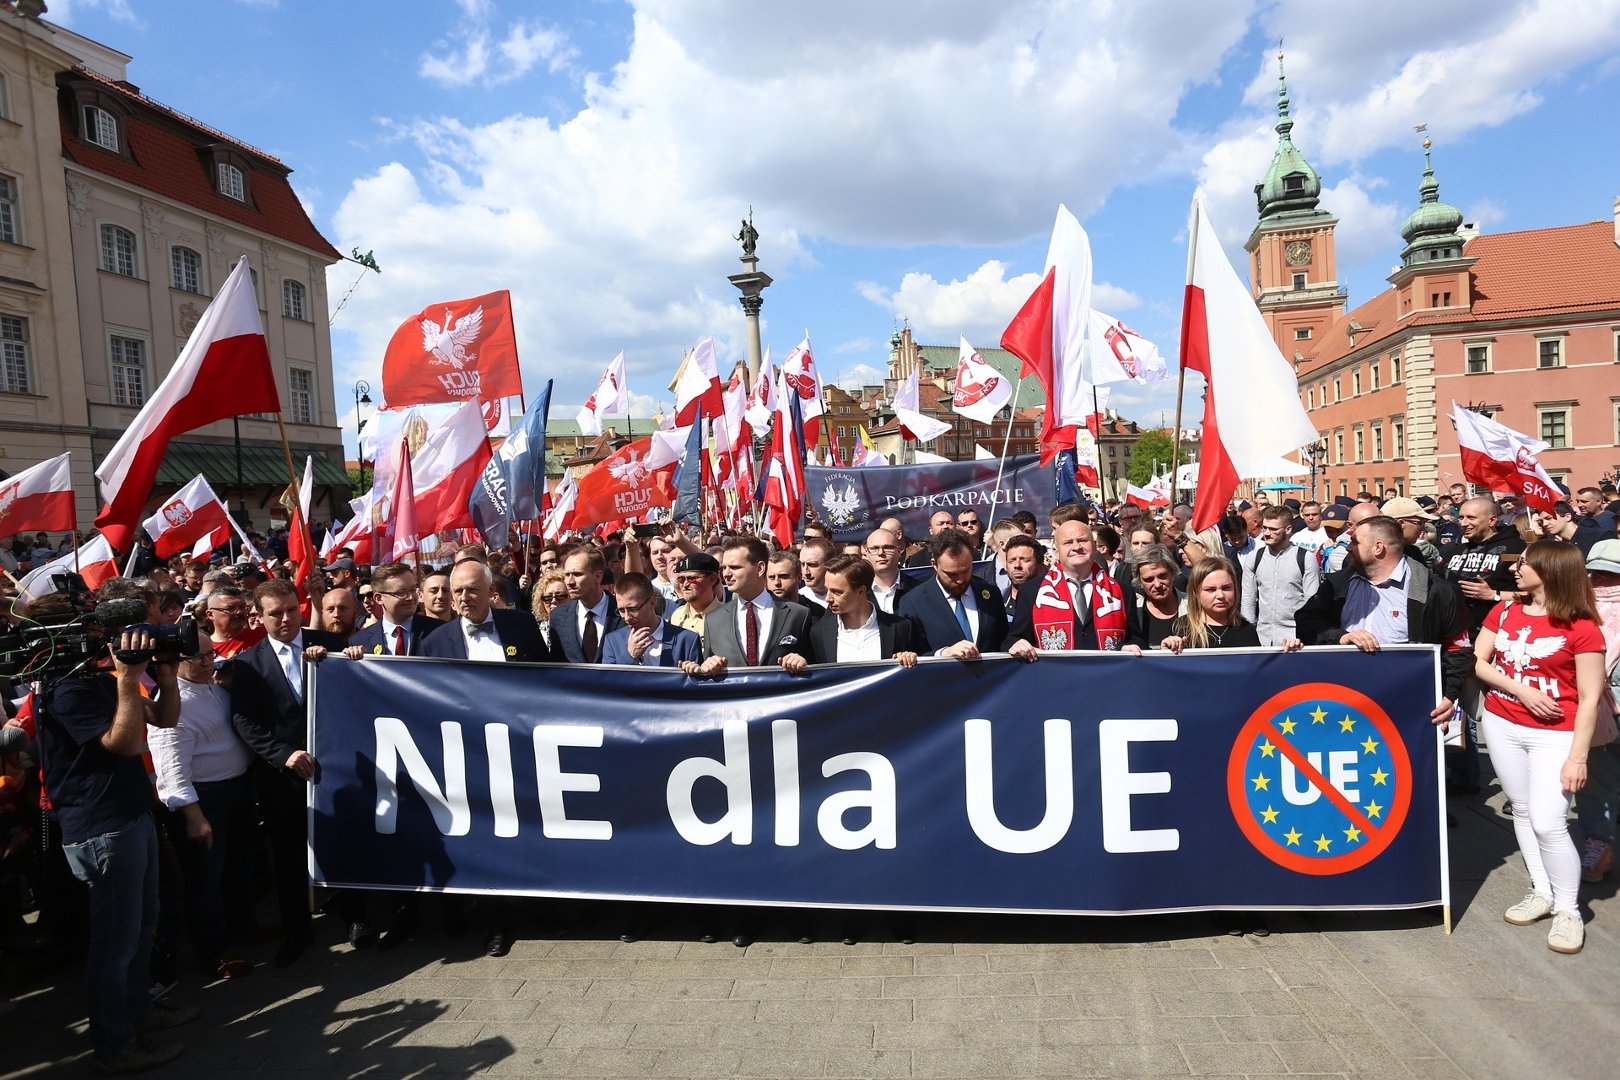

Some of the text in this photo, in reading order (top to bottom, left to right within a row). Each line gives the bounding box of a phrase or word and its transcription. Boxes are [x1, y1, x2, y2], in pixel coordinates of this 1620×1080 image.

[885, 489, 1024, 510] PODKARPACIE
[374, 717, 1180, 854] NIE dla UE
[1280, 750, 1361, 806] UE
